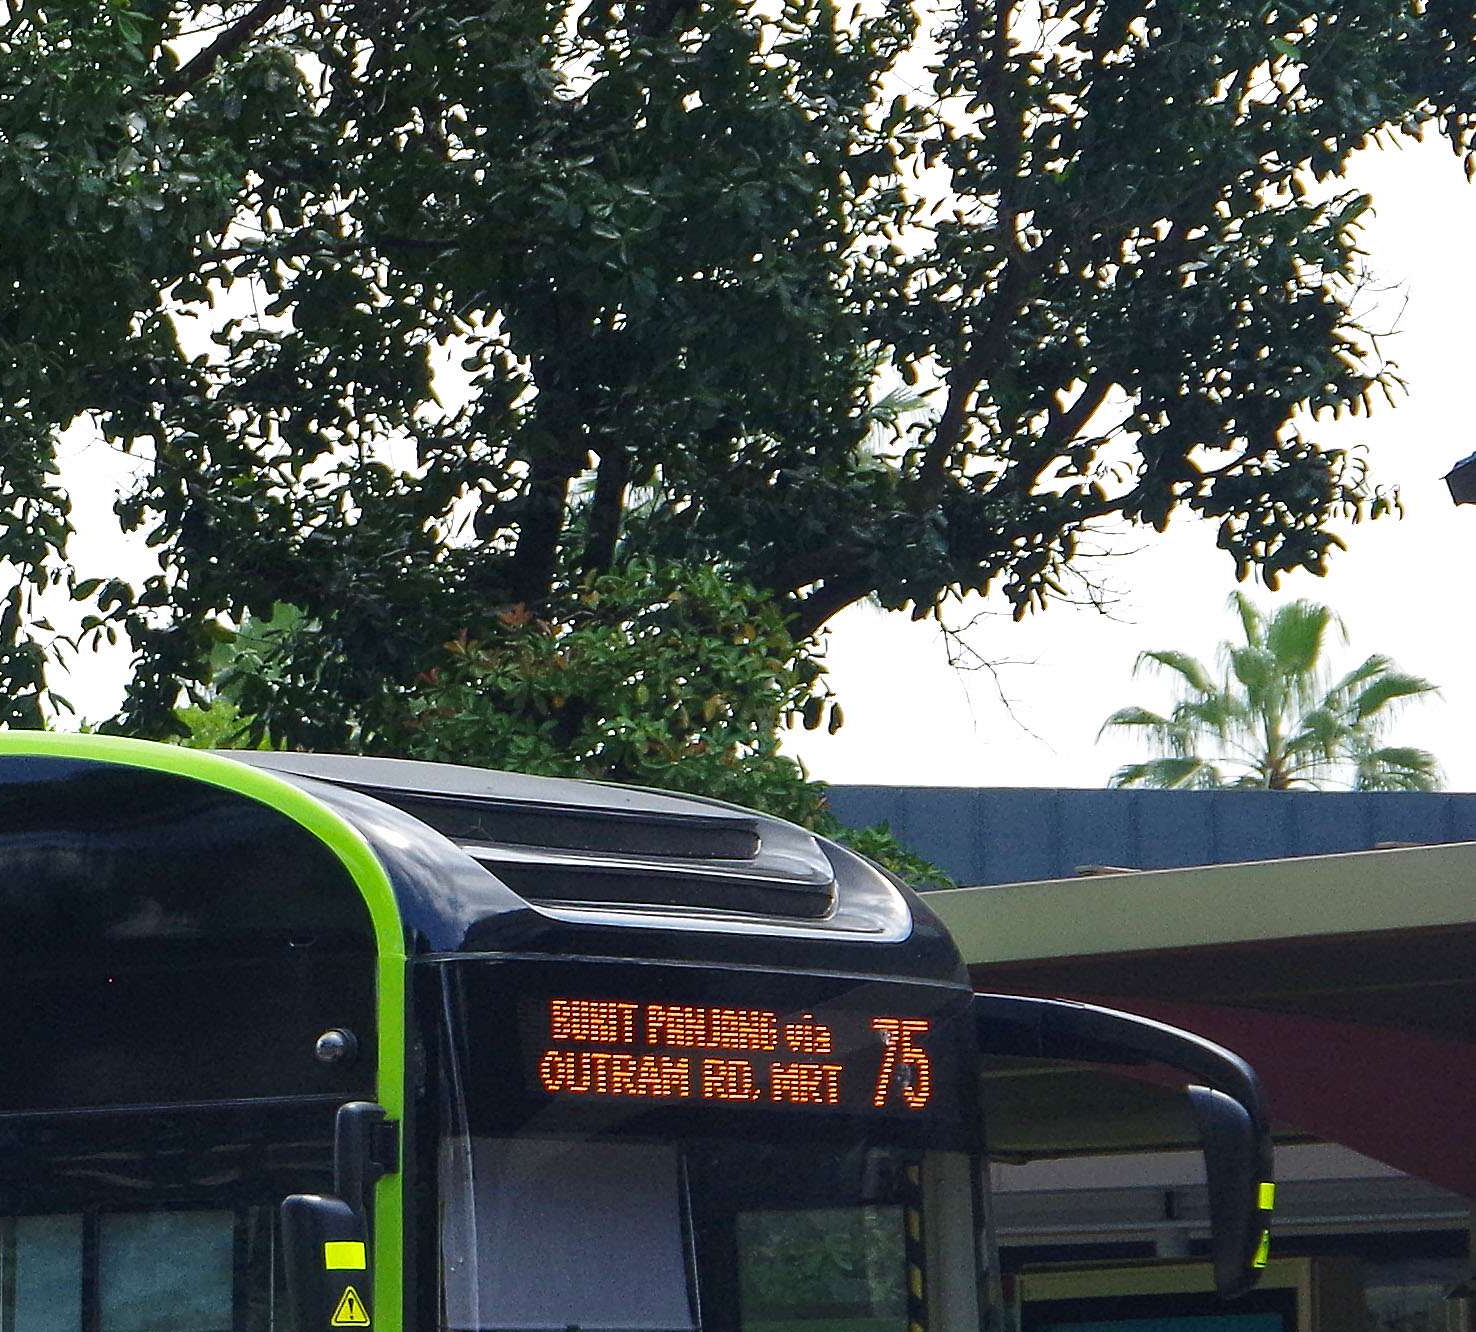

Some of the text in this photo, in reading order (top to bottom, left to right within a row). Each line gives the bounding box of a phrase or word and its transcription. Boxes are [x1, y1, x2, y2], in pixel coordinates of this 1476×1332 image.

[551, 999, 833, 1053] BUKIT PANJANG via
[538, 1050, 689, 1098] OUTRAM
[771, 1061, 843, 1105] MRT
[871, 1017, 931, 1108] 75
